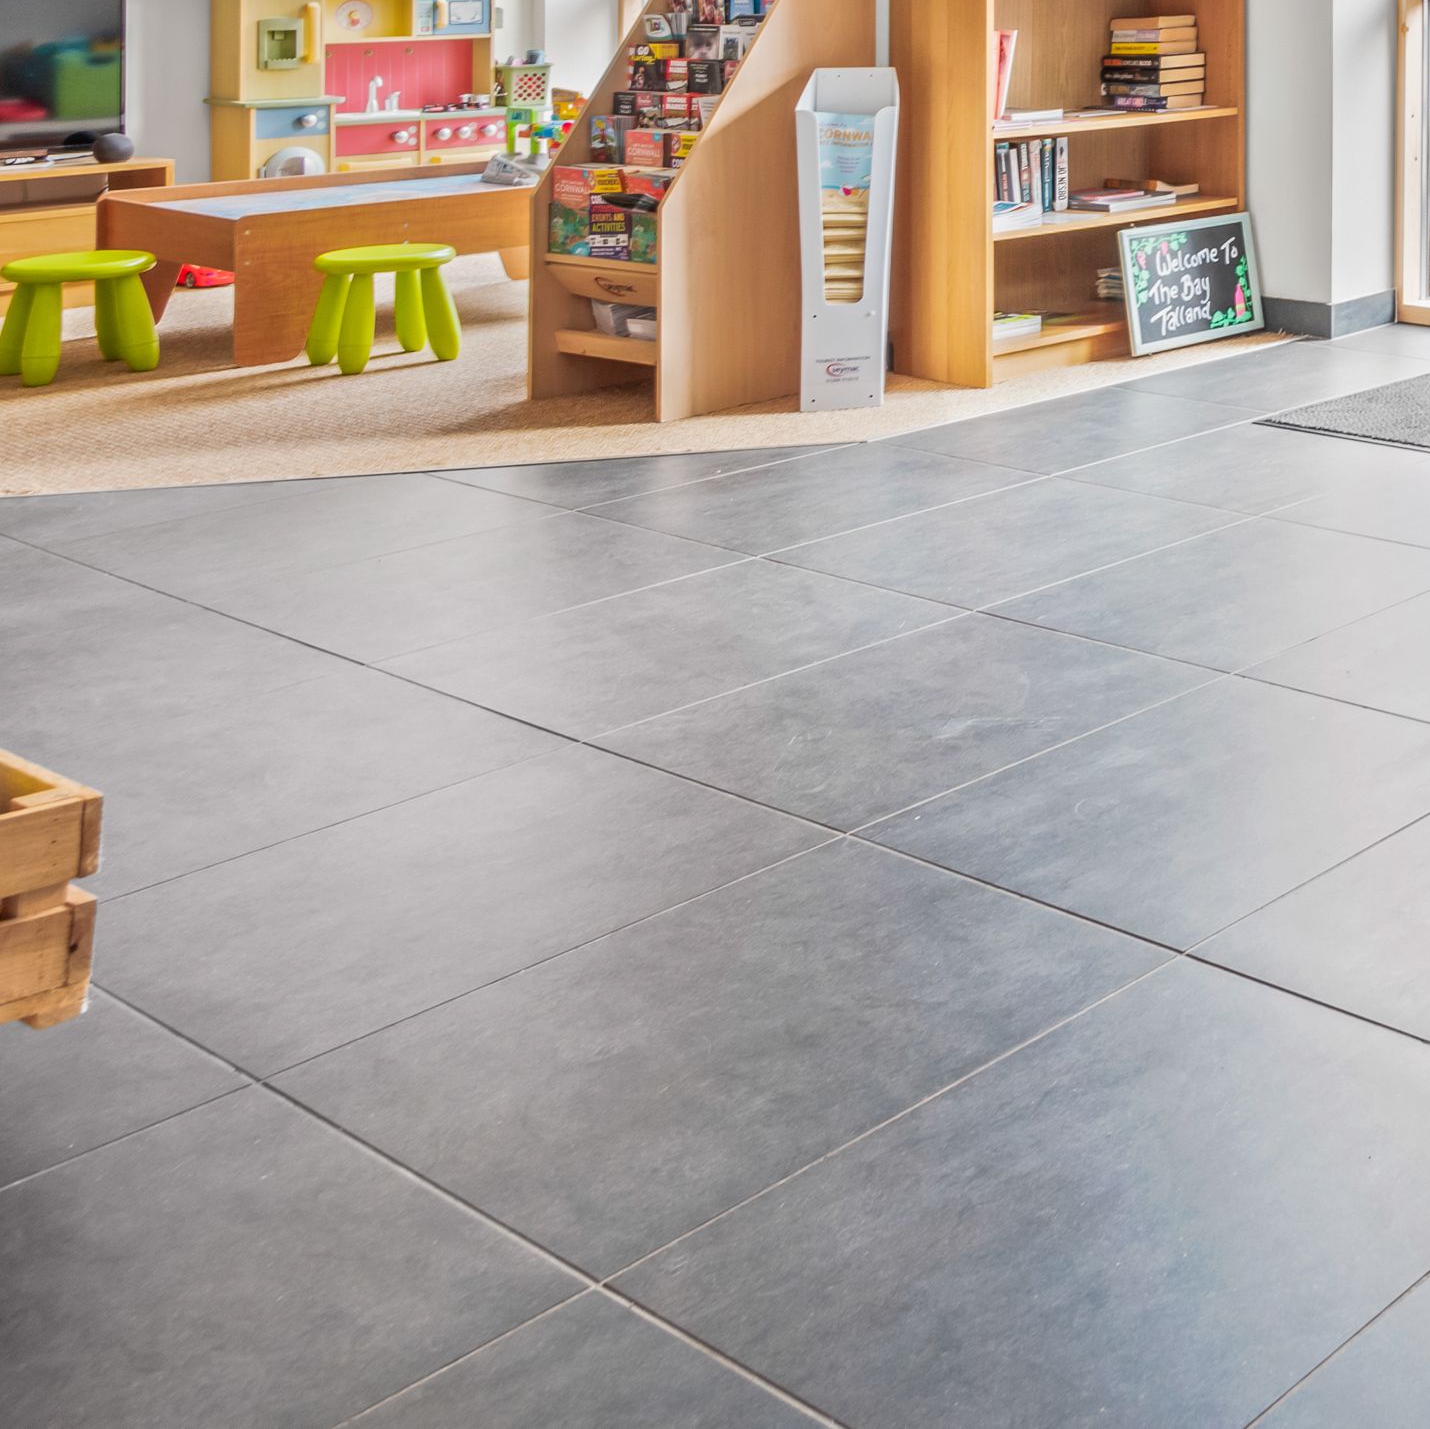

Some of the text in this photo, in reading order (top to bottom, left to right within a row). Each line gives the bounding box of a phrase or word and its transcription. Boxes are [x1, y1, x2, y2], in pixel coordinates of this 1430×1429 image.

[1058, 166, 1068, 176] JO
[591, 212, 613, 222] EVENTS
[591, 221, 626, 233] ACTIVITIES
[1156, 237, 1238, 276] Welcome To
[1149, 274, 1211, 305] The Bay
[1150, 301, 1212, 336] Talland
